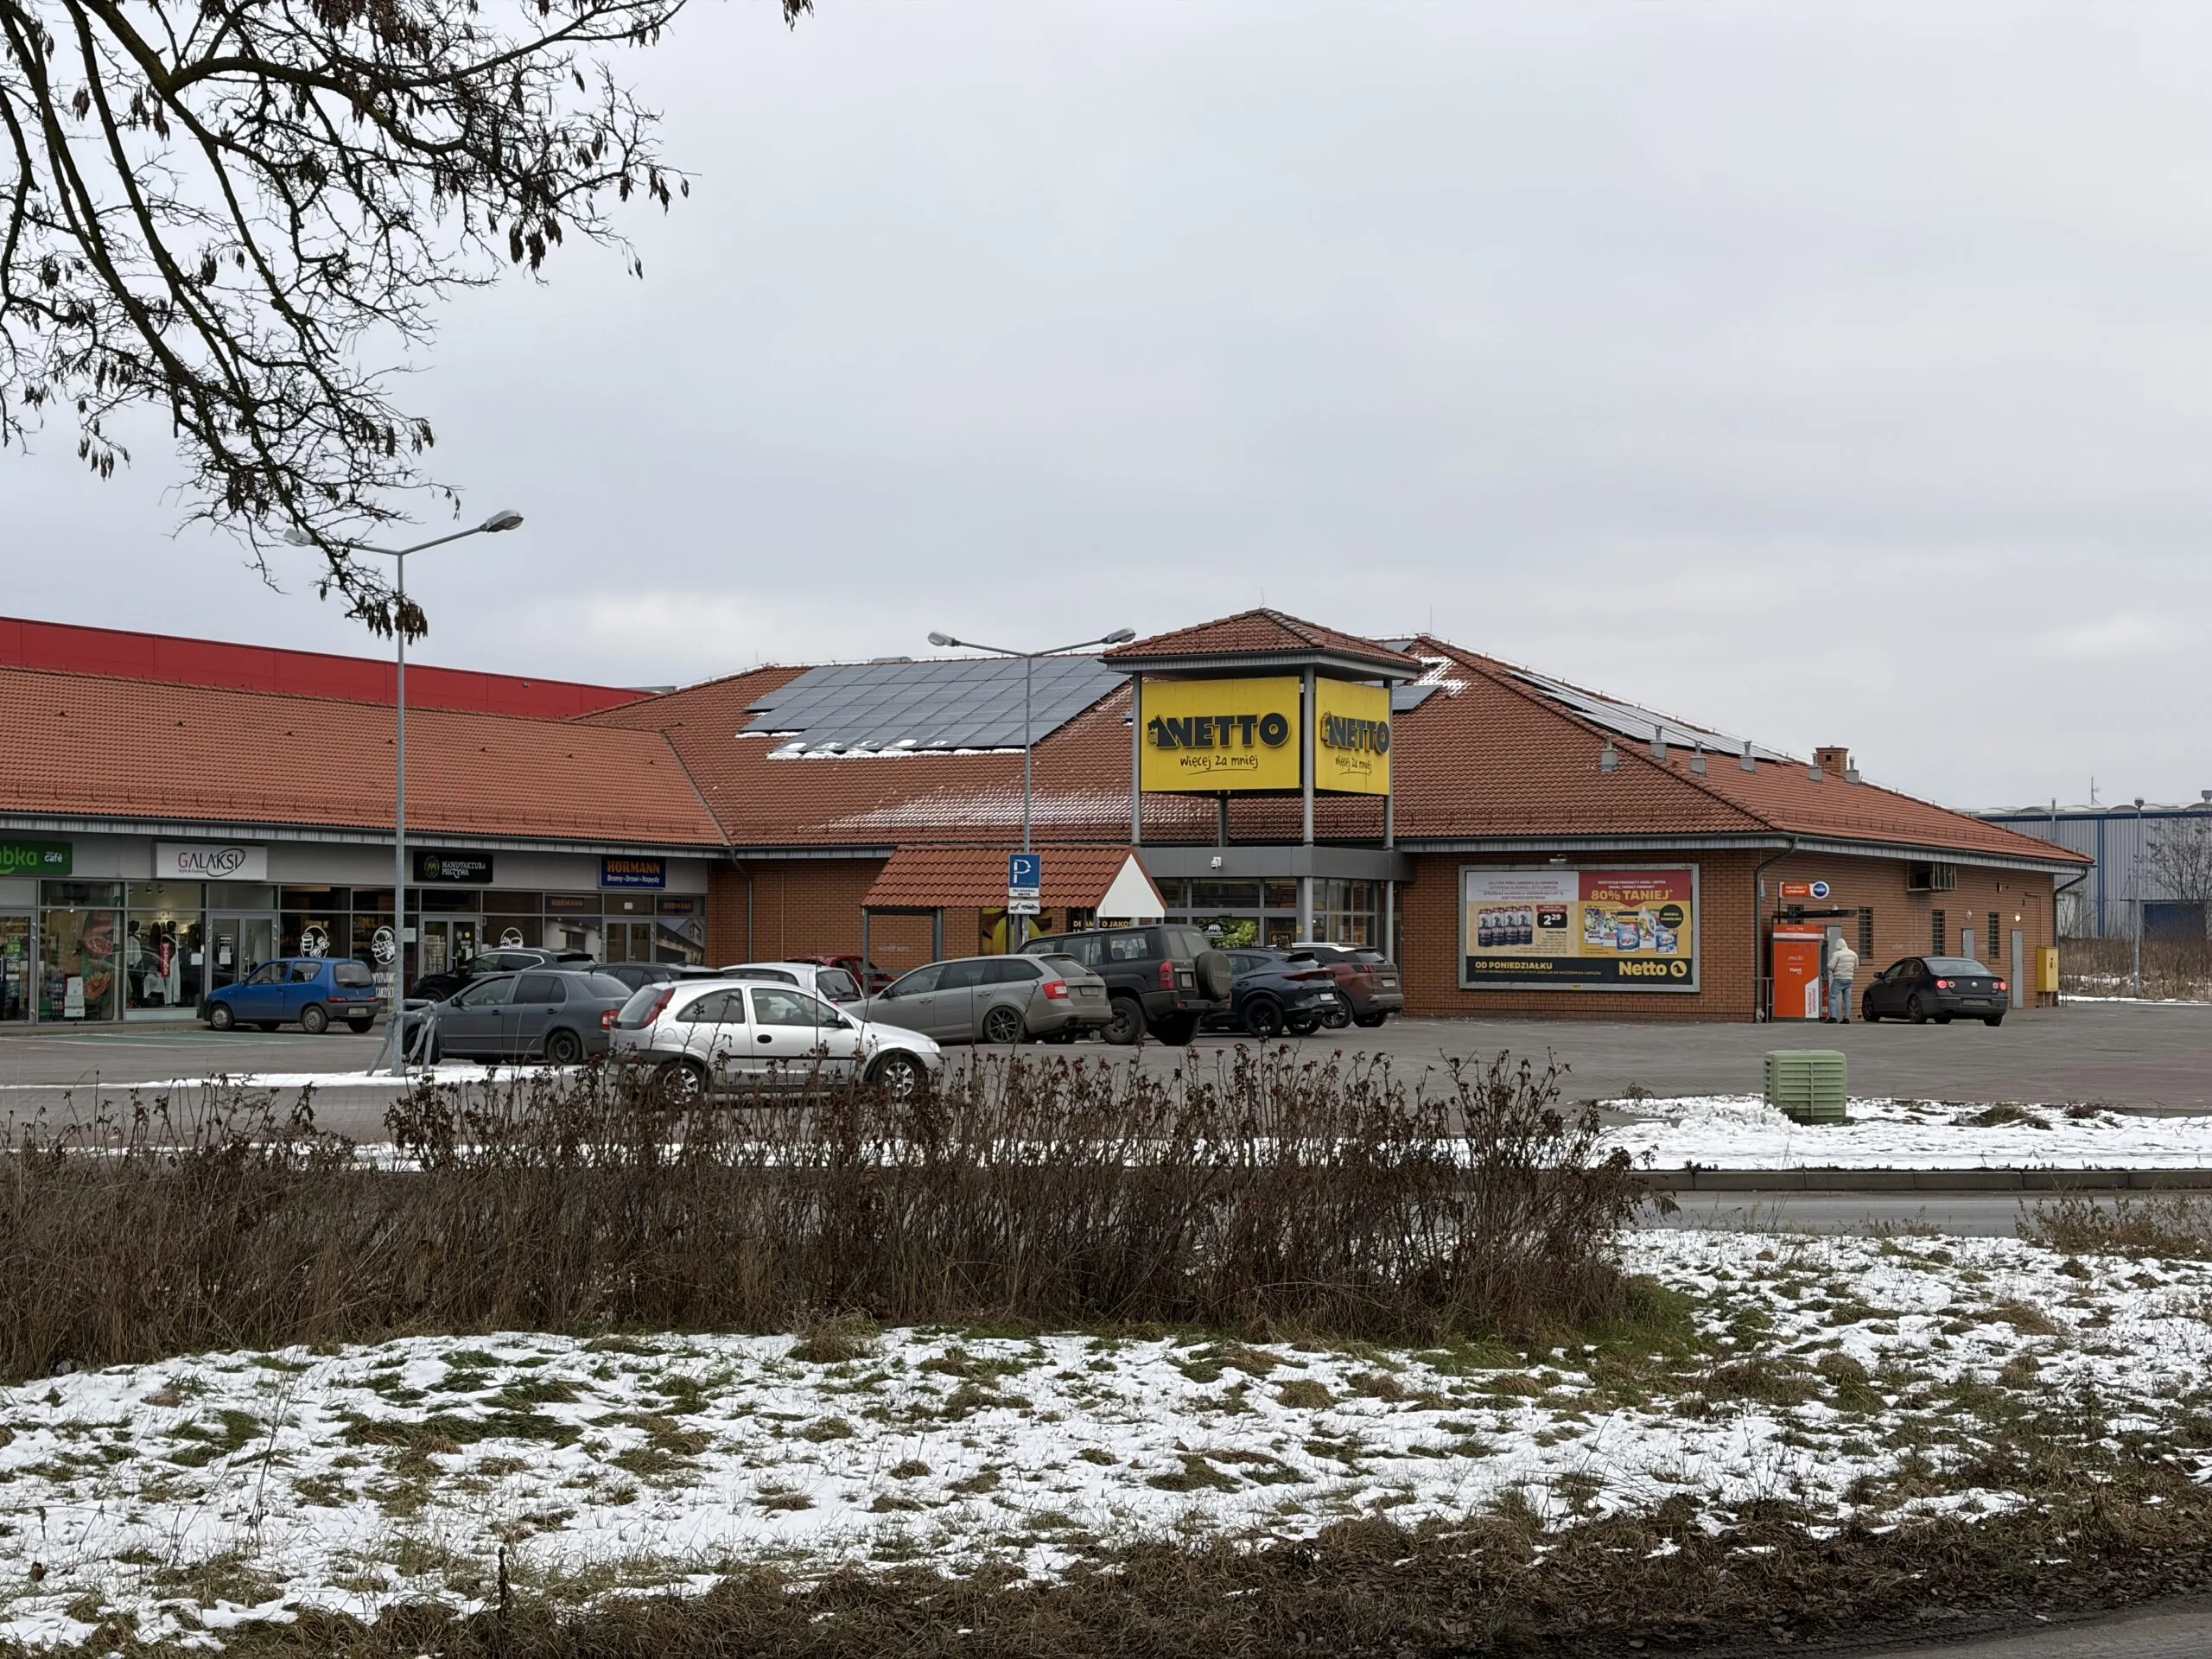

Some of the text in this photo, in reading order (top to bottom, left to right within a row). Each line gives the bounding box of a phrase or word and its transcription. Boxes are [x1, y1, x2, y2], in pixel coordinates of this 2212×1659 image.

[1166, 712, 1290, 748] NETTO
[1332, 716, 1390, 755] NETTO
[1230, 753, 1259, 769] mniej
[44, 851, 63, 862] café
[178, 852, 238, 869] GALAKSI
[1014, 859, 1032, 884] P
[1591, 890, 1620, 900] 80%
[1618, 961, 1668, 976] Netto
